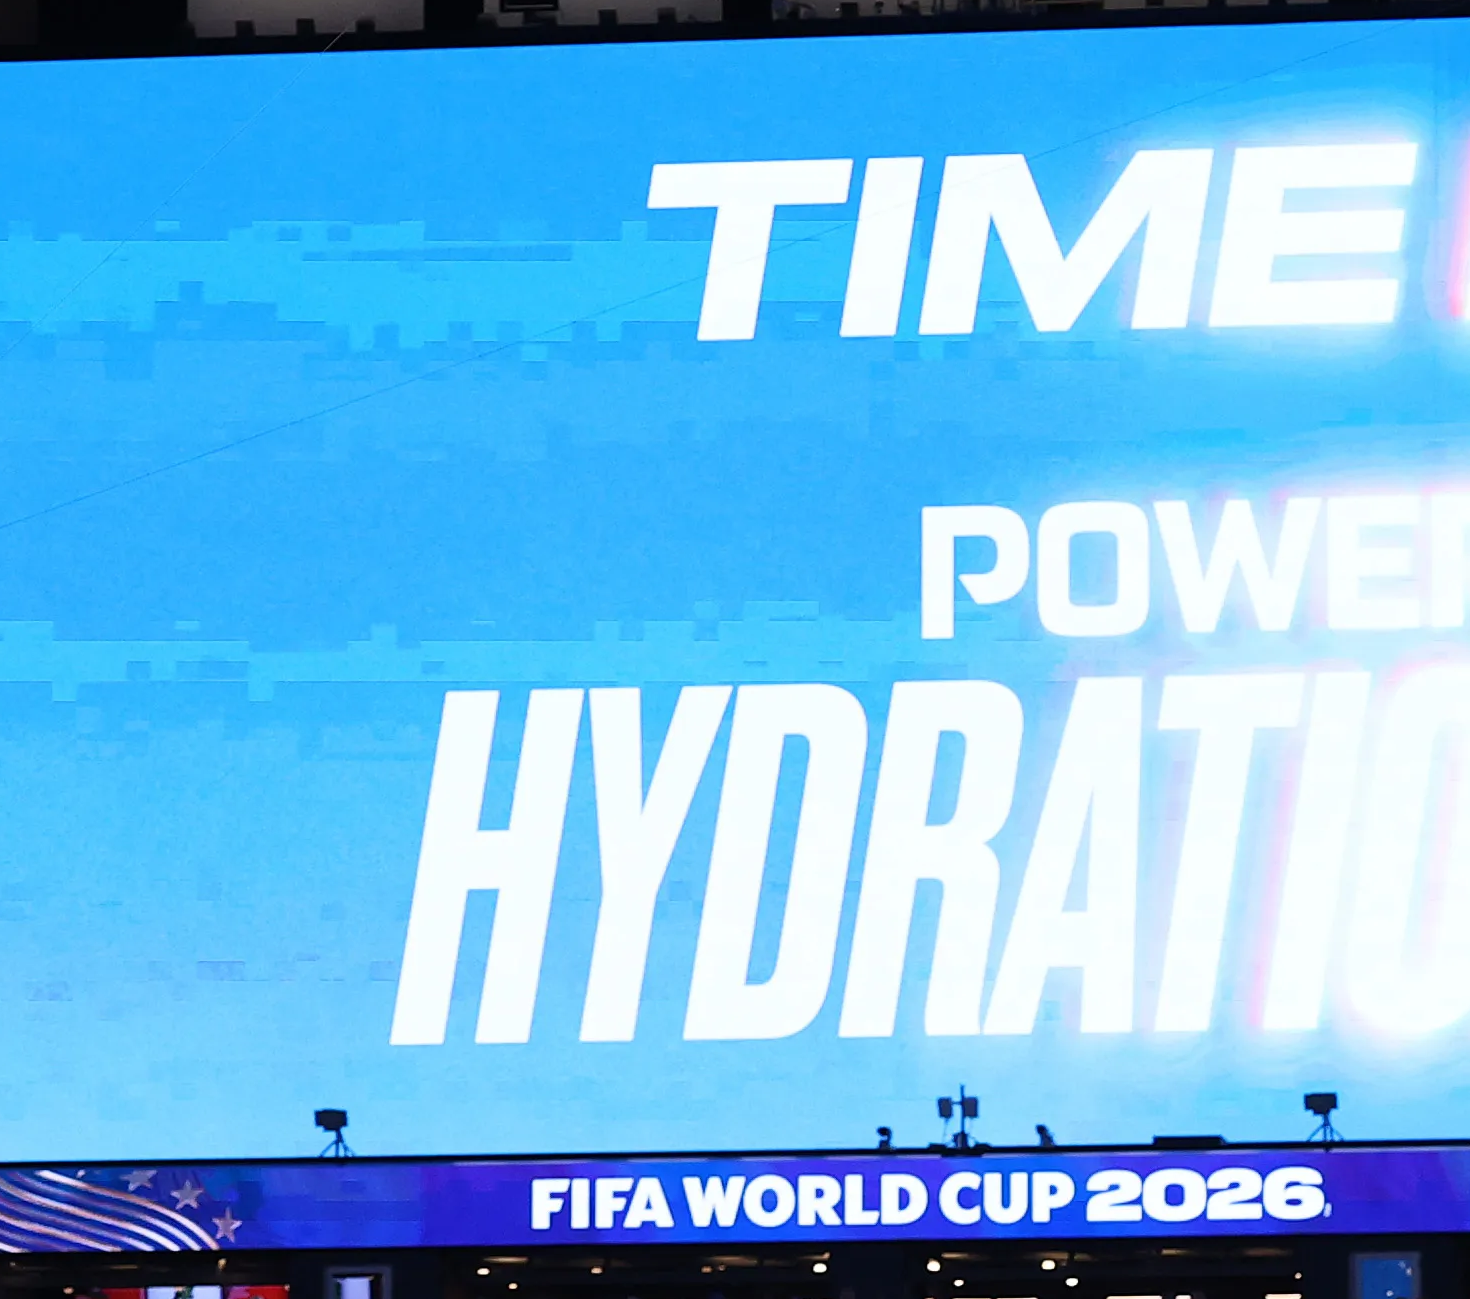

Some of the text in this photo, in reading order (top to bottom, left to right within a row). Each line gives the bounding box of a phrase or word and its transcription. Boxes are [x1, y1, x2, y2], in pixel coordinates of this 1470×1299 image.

[647, 142, 1418, 342] TIME
[531, 1165, 1326, 1230] FIFA WORLD CUP 2026
